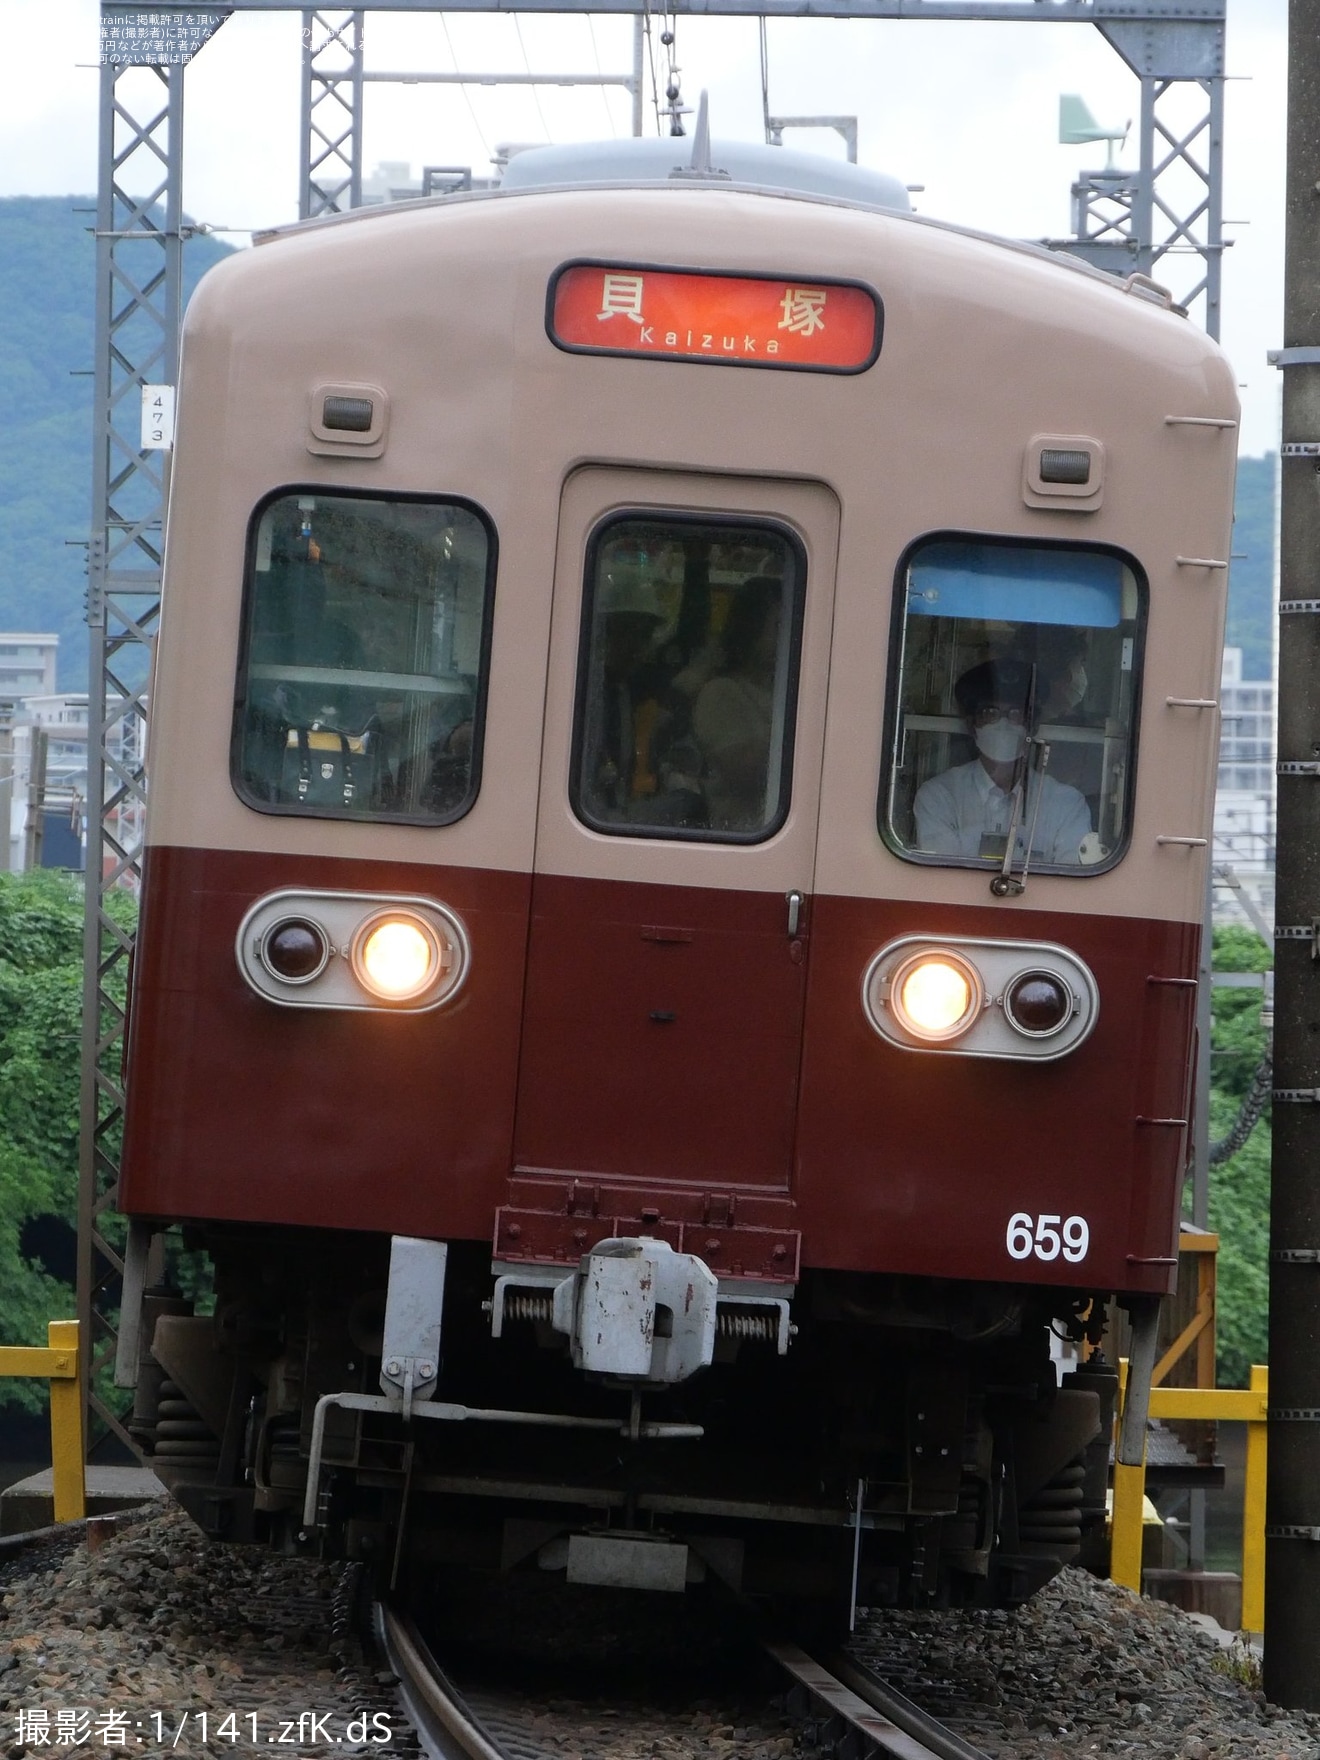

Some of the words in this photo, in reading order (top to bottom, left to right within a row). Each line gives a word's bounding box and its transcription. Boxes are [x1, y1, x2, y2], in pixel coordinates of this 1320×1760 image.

[639, 325, 780, 355] Kaizuka
[151, 396, 164, 442] 473
[1005, 1211, 1091, 1264] 659
